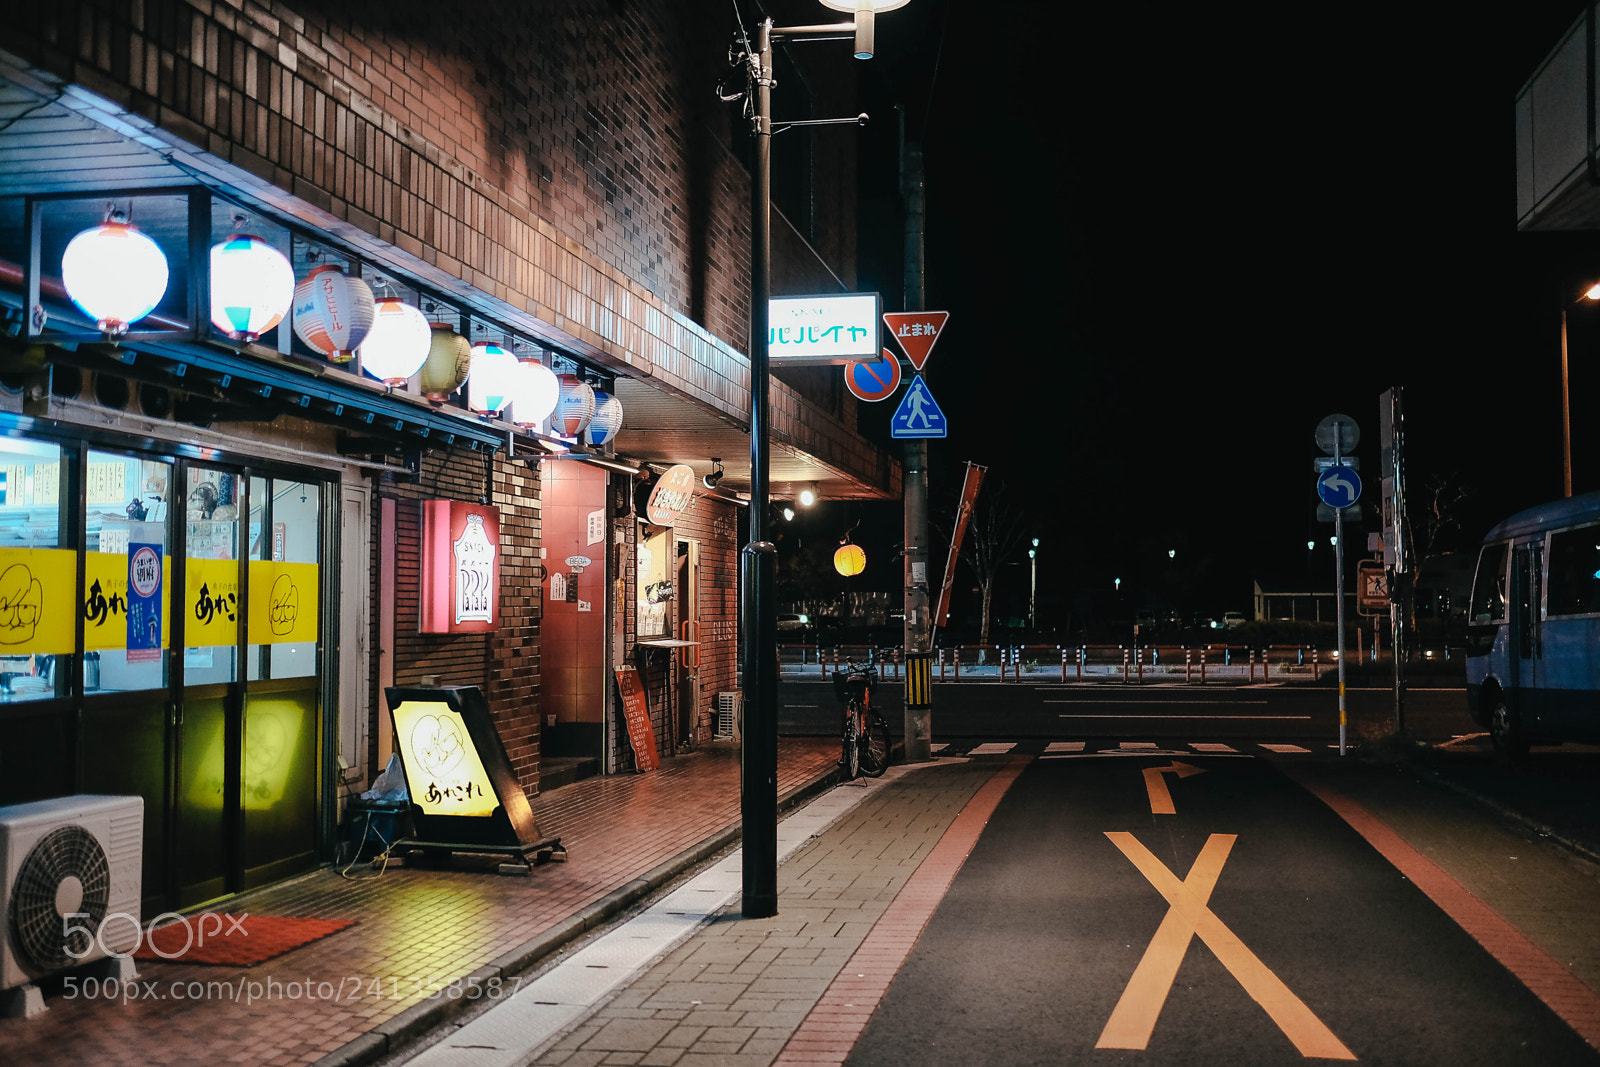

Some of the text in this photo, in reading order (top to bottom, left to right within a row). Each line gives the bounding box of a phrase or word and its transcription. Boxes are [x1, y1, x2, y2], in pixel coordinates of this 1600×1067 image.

[321, 278, 344, 331] アサヒビール
[769, 326, 867, 344] パパイヤ
[898, 322, 937, 337] 止まれ
[137, 566, 154, 582] 別府
[85, 578, 127, 627] あれ
[195, 582, 239, 626] あれこ
[424, 781, 484, 805] あれこれ
